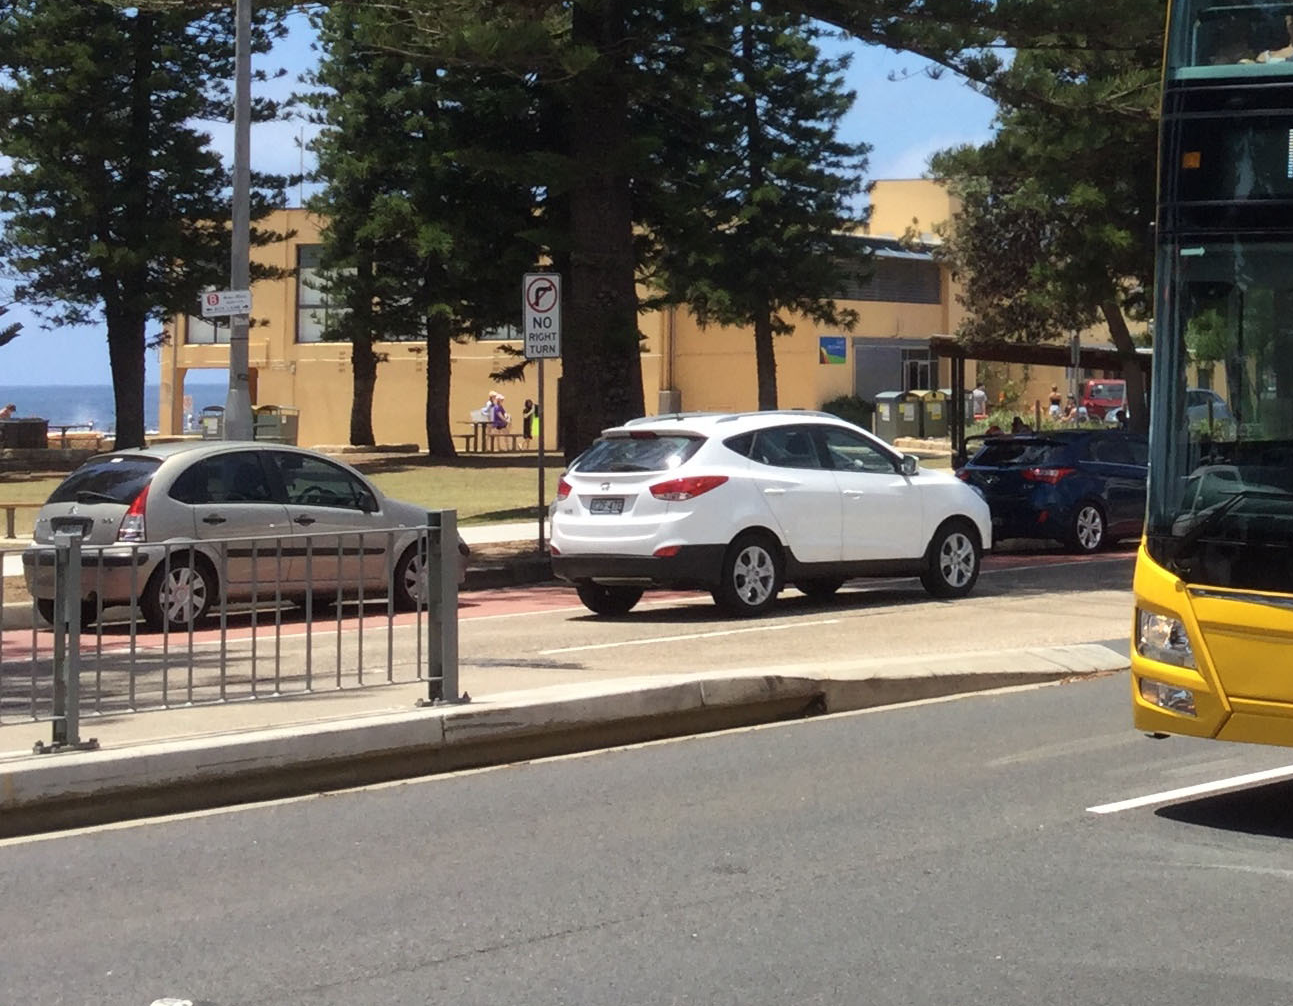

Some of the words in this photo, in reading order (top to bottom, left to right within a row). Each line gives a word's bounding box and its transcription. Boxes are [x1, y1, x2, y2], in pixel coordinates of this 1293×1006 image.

[533, 316, 552, 329] NO
[528, 332, 557, 342] RIGHT
[529, 344, 556, 354] TURN
